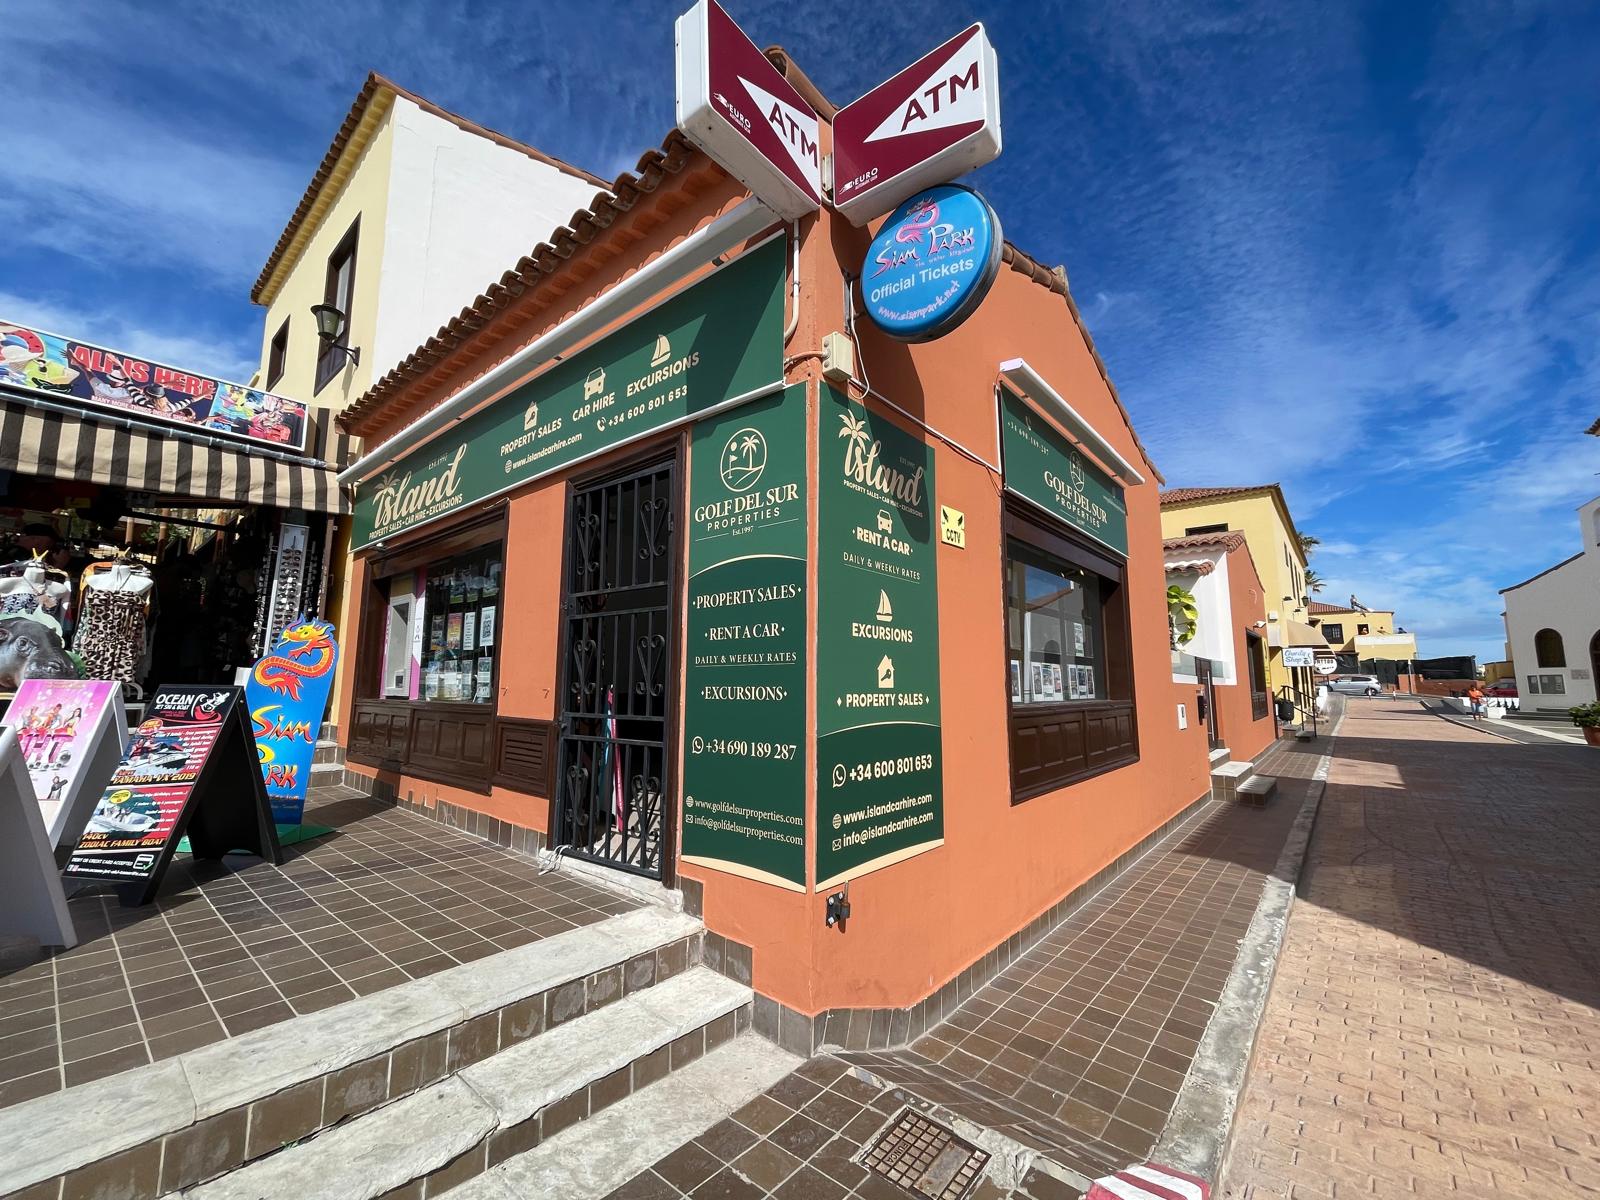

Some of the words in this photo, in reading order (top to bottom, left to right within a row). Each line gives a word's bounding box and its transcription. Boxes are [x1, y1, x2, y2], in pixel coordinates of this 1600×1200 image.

[900, 61, 979, 132] ATM
[729, 104, 751, 129] EURO
[768, 102, 818, 168] ATM
[854, 167, 878, 185] EURO
[871, 274, 915, 303] Official
[919, 258, 974, 283] Tickets
[122, 358, 150, 383] IS
[154, 367, 215, 400] HERE
[626, 351, 700, 397] EXCURSIONS
[572, 404, 591, 422] CAR
[592, 392, 616, 413] HIRE
[608, 413, 625, 427] +34
[627, 403, 645, 420] 600
[648, 395, 665, 411] 801
[668, 385, 688, 402] 653
[500, 430, 537, 457] PROPERTY
[537, 418, 562, 438] SALES
[512, 432, 582, 470] www.islandcarhire.com
[372, 443, 467, 529] Island
[844, 438, 924, 506] Island
[694, 499, 733, 522] GOLF
[734, 492, 764, 513] DEL
[766, 483, 799, 506] SUR
[843, 479, 866, 494] PROPERTY
[866, 489, 880, 499] SALES
[1044, 470, 1072, 500] GOLF
[1074, 490, 1091, 513] DEL
[1092, 502, 1108, 524] SUR
[368, 526, 389, 540] PROPERTY
[389, 520, 403, 532] SALES
[405, 516, 414, 525] CAR
[429, 493, 463, 515] EXCURSIONS
[707, 507, 780, 531] PROPERTIES
[1055, 493, 1100, 528] PROPERTIES
[856, 526, 882, 546] RENT
[883, 537, 891, 550] A
[891, 538, 910, 555] CAR
[946, 528, 961, 544] CCTV
[843, 552, 865, 565] DAILY
[867, 558, 873, 568] &
[875, 561, 900, 575] WEEKLY
[902, 568, 920, 580] RATES
[696, 588, 757, 609] PROPERTY
[757, 583, 796, 602] SALES
[709, 625, 741, 641] RENT
[742, 625, 751, 639] A
[752, 622, 780, 638] CAR
[852, 622, 913, 643] EXCURSIONS
[695, 655, 719, 664] DAILY
[720, 655, 727, 663] &
[729, 653, 764, 663] WEEKLY
[767, 652, 797, 662] RATES
[156, 694, 195, 705] OCEAN
[704, 686, 783, 701] EXCURSIONS
[846, 693, 895, 708] PROPERTY
[898, 693, 923, 706] SALES
[706, 739, 725, 754] +34
[727, 740, 748, 756] 690
[751, 742, 771, 758] 189
[774, 744, 797, 760] 287
[171, 772, 197, 780] 2019
[849, 763, 872, 782] +34
[874, 760, 895, 777] 600
[897, 757, 914, 774] 801
[915, 754, 933, 771] 653
[695, 799, 804, 826] www.golfdelsurproperties.com
[843, 792, 933, 825] www.islandcarhire.com
[110, 839, 140, 847] FAMILY
[141, 838, 165, 846] BOAT
[694, 815, 804, 845] info@golfdelsurproperties.com
[843, 810, 934, 848] info@islandcarhire.com
